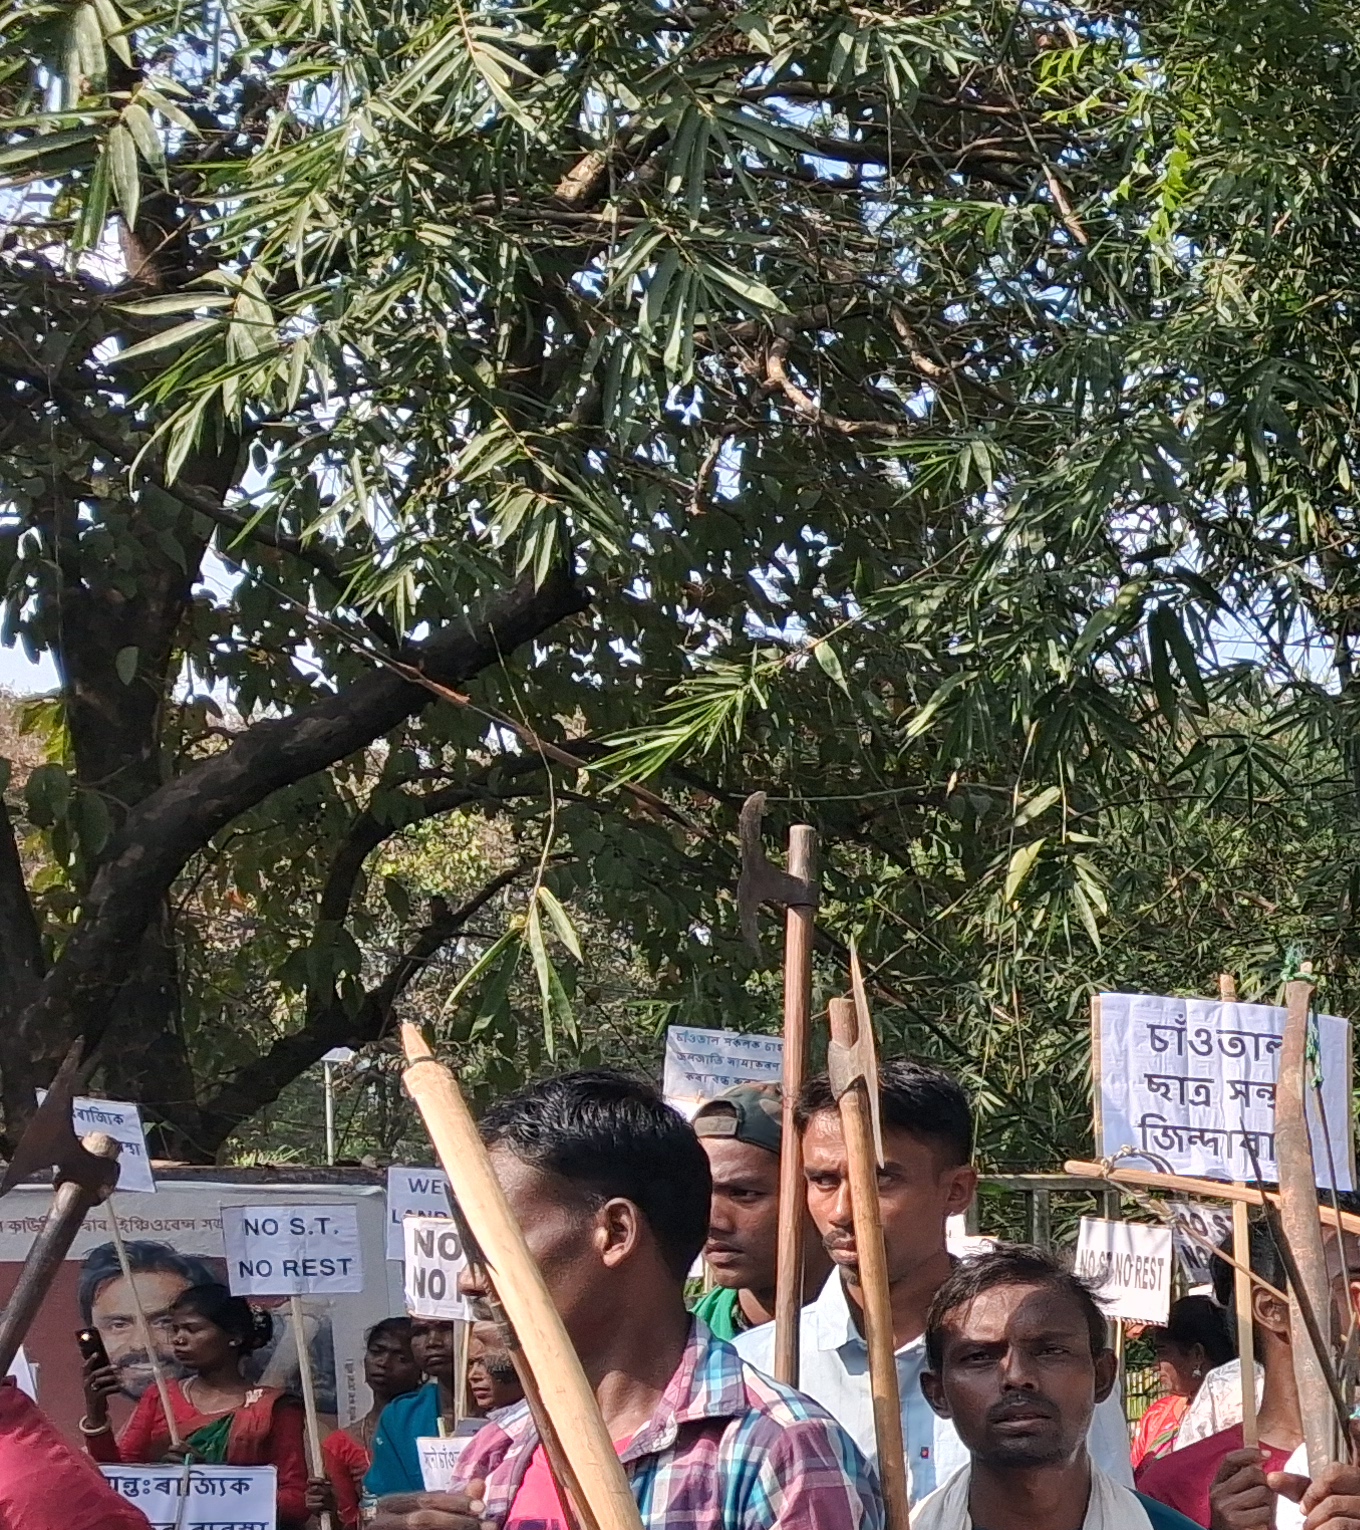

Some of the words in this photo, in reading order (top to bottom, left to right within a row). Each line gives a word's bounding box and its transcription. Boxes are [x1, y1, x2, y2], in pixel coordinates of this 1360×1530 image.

[1136, 1113, 1275, 1162] জিন্দাবা
[408, 1178, 443, 1195] WE
[244, 1218, 279, 1236] NO
[289, 1217, 340, 1236] S.T.
[413, 1227, 463, 1262] NO
[238, 1259, 273, 1279] NO
[282, 1257, 353, 1278] REST
[413, 1266, 446, 1301] NO
[1134, 1255, 1165, 1292] REST
